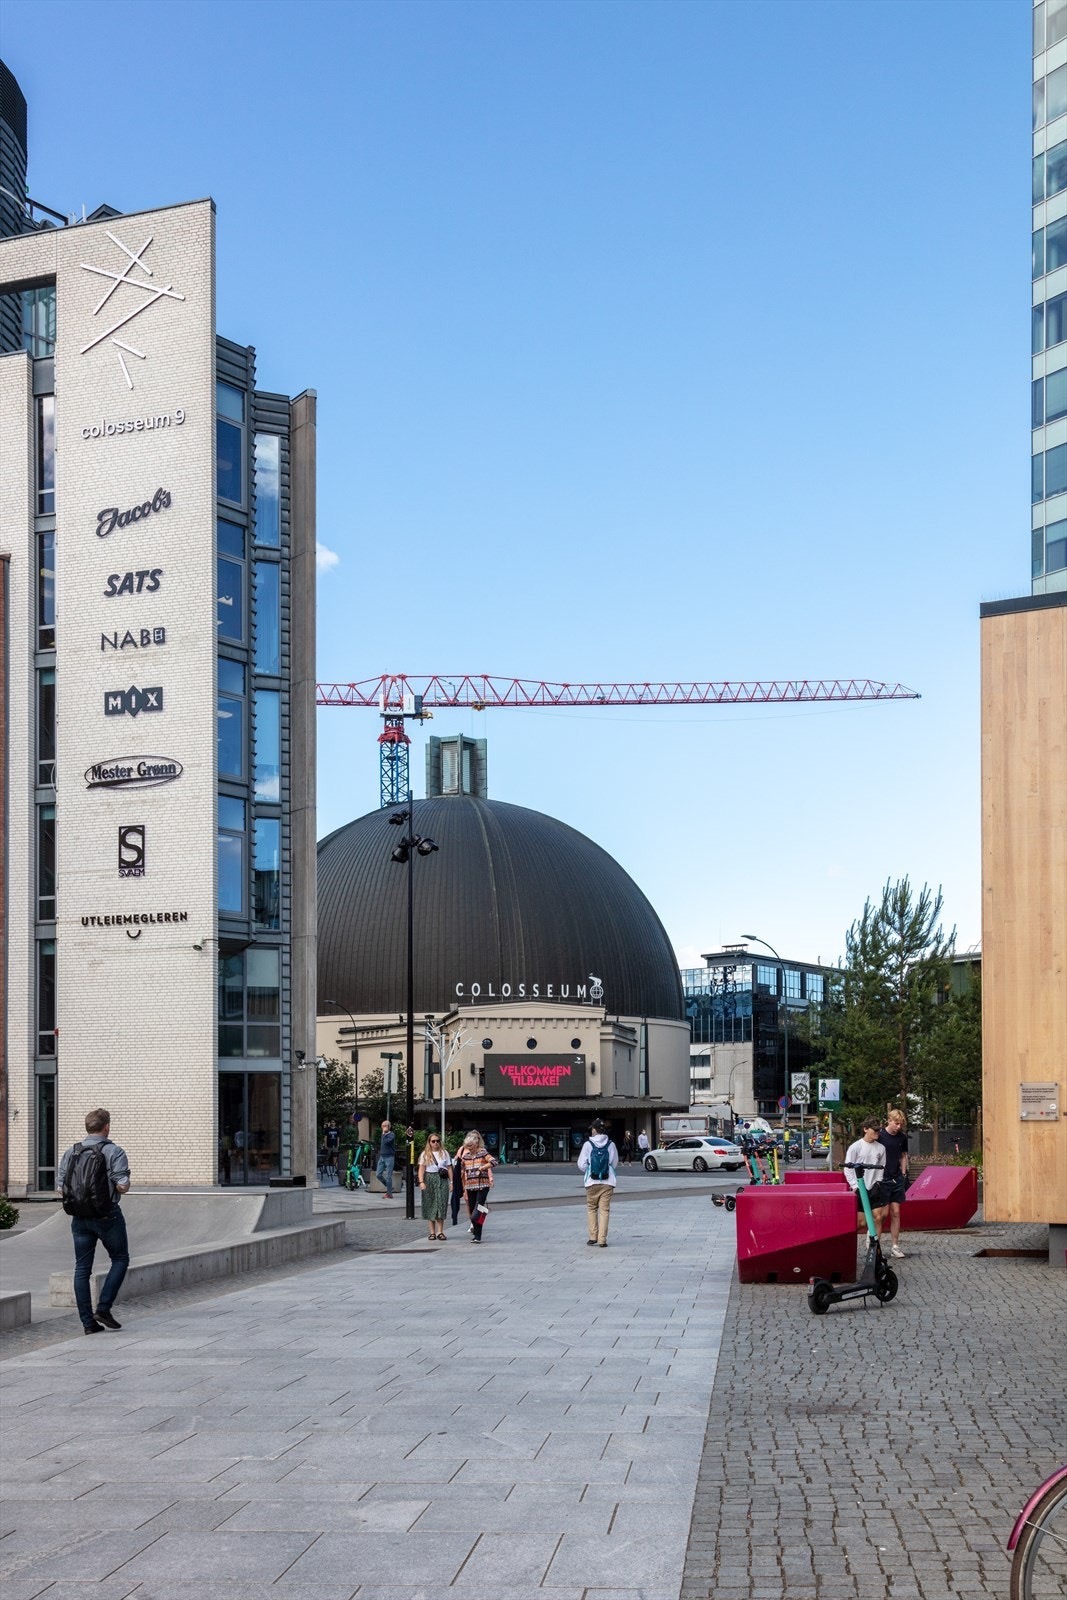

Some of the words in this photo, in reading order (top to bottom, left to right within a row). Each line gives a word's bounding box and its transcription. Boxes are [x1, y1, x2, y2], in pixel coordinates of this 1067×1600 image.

[81, 414, 171, 440] colosseum
[175, 408, 186, 426] 9
[95, 487, 172, 538] Jacob's
[104, 568, 163, 597] SATS
[107, 690, 160, 712] MIX
[91, 764, 133, 780] Mester
[137, 761, 177, 777] Grønn
[81, 911, 188, 927] UTLEIEMEGLEREN
[455, 982, 587, 998] COLOSSEUM
[499, 1065, 571, 1076] VELKOMMEN
[511, 1075, 560, 1086] TILBAKE!
